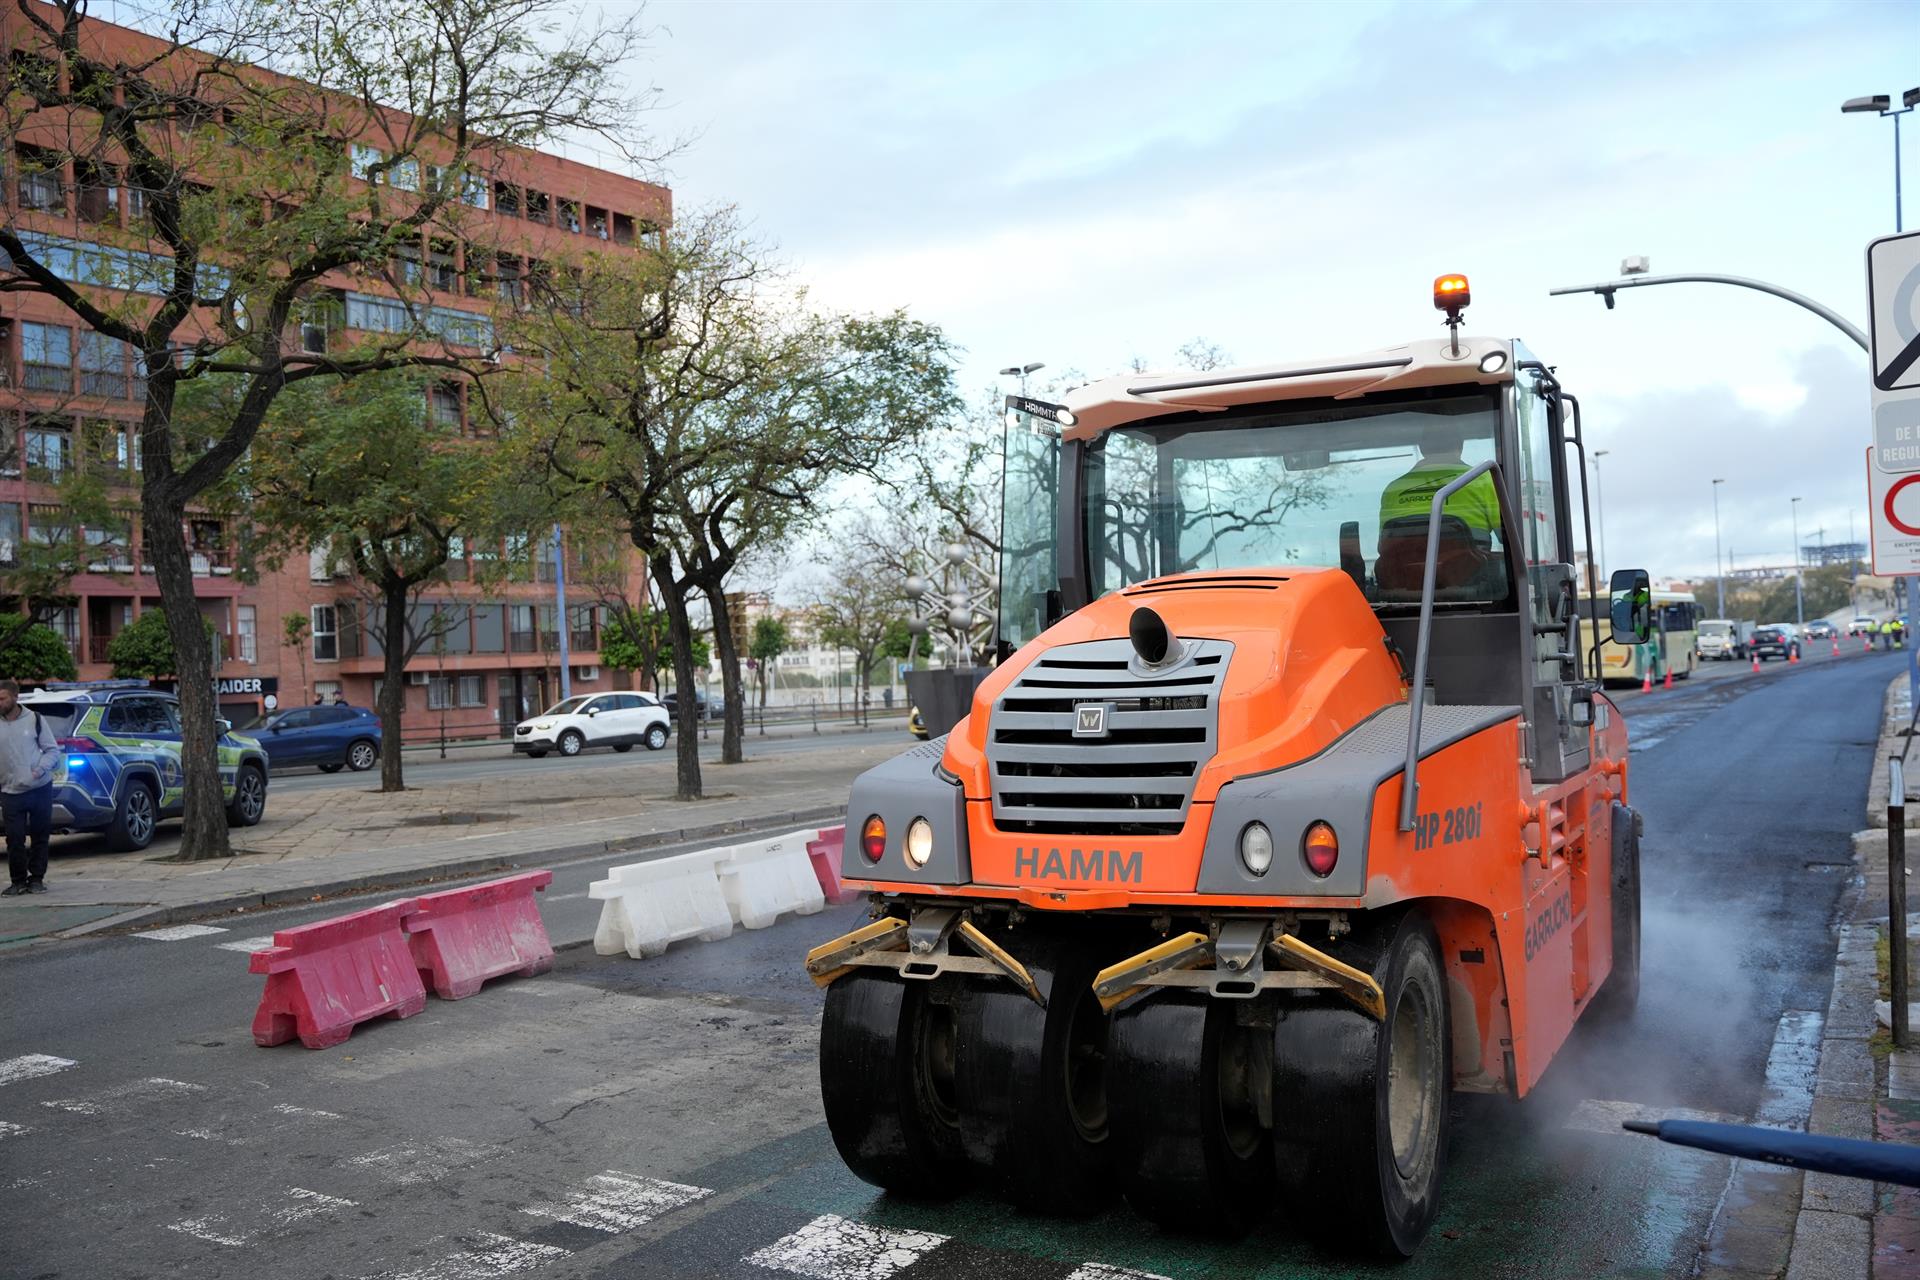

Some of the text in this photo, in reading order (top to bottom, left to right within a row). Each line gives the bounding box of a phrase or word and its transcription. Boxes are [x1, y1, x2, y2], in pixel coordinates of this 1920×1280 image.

[1024, 401, 1058, 420] HAMMTR
[1896, 426, 1911, 441] DE
[1414, 801, 1482, 851] HP 280i
[1014, 847, 1143, 883] HAMM
